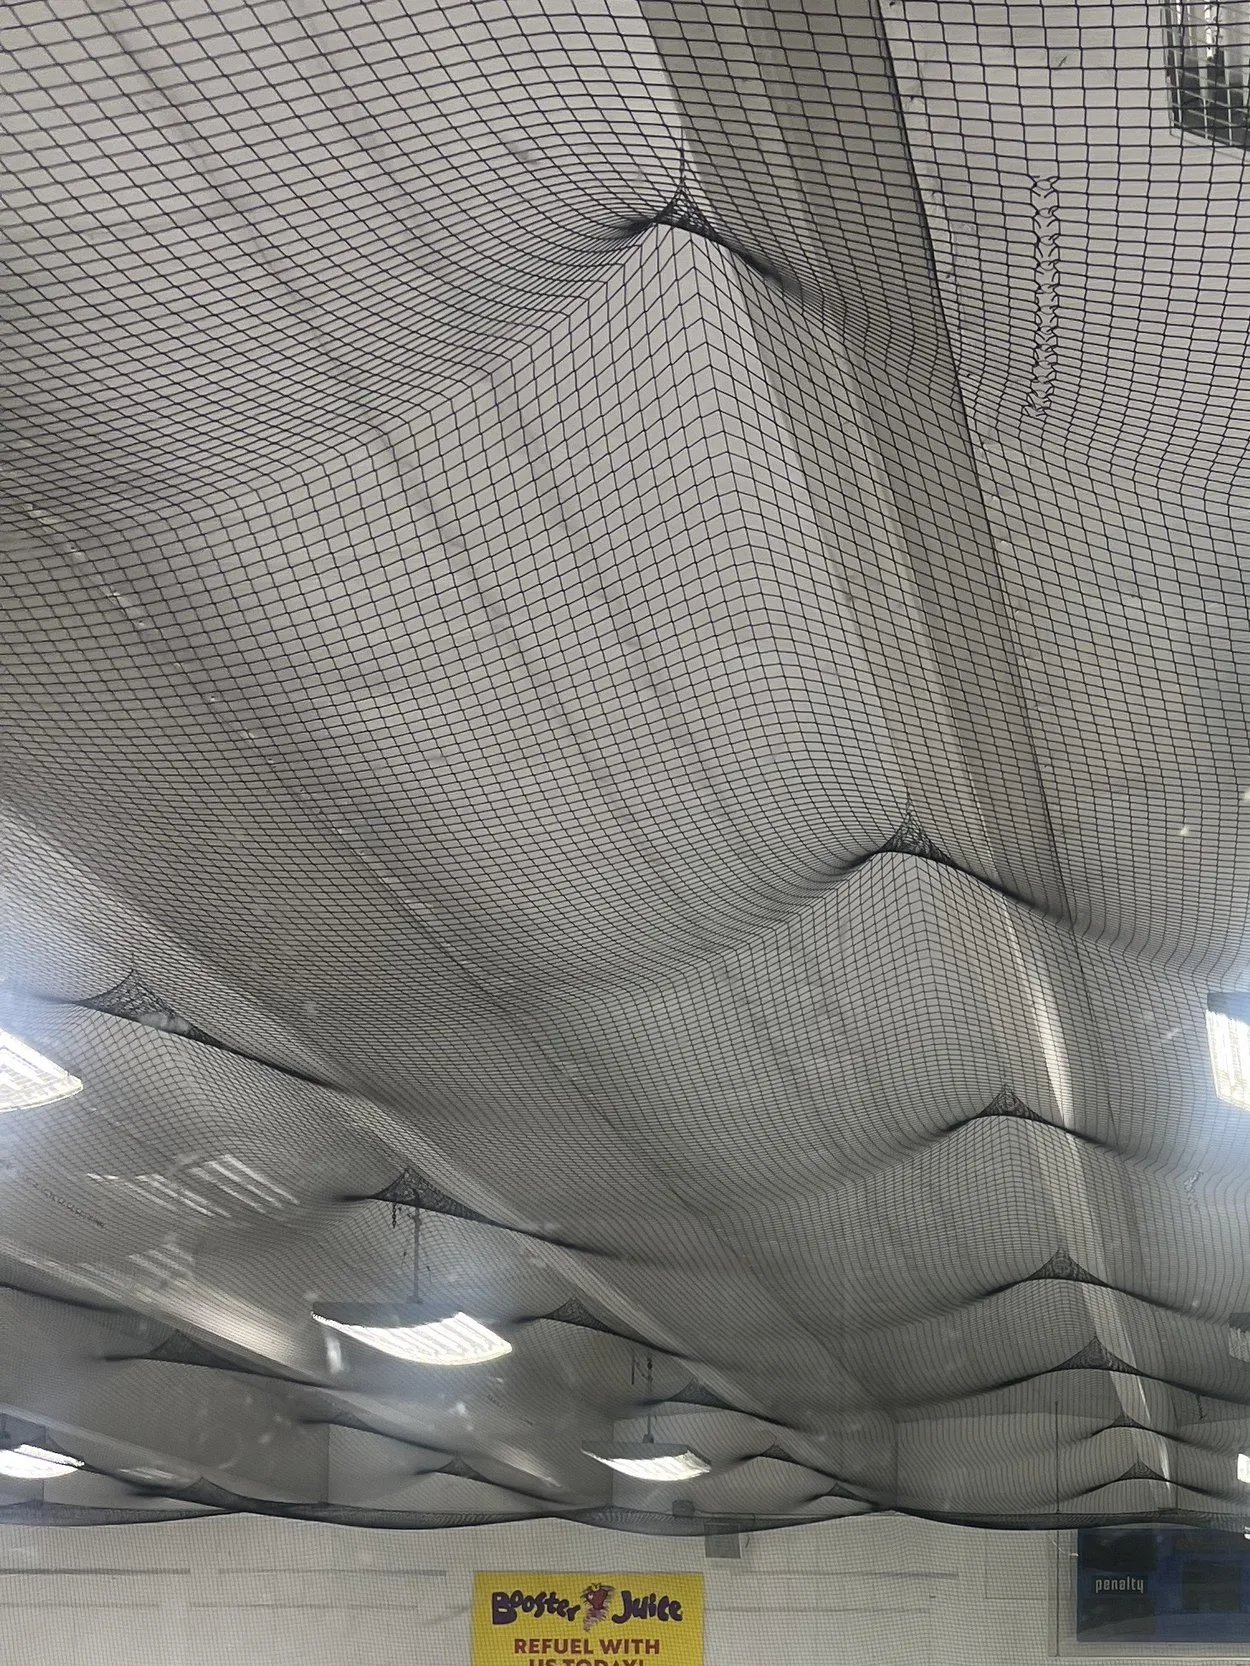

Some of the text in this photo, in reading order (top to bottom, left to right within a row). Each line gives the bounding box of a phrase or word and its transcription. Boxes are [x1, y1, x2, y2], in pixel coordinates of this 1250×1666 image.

[1095, 1576, 1144, 1594] penalty
[492, 1589, 683, 1625] Booster Juice
[514, 1638, 660, 1655] REFUEL WITH
